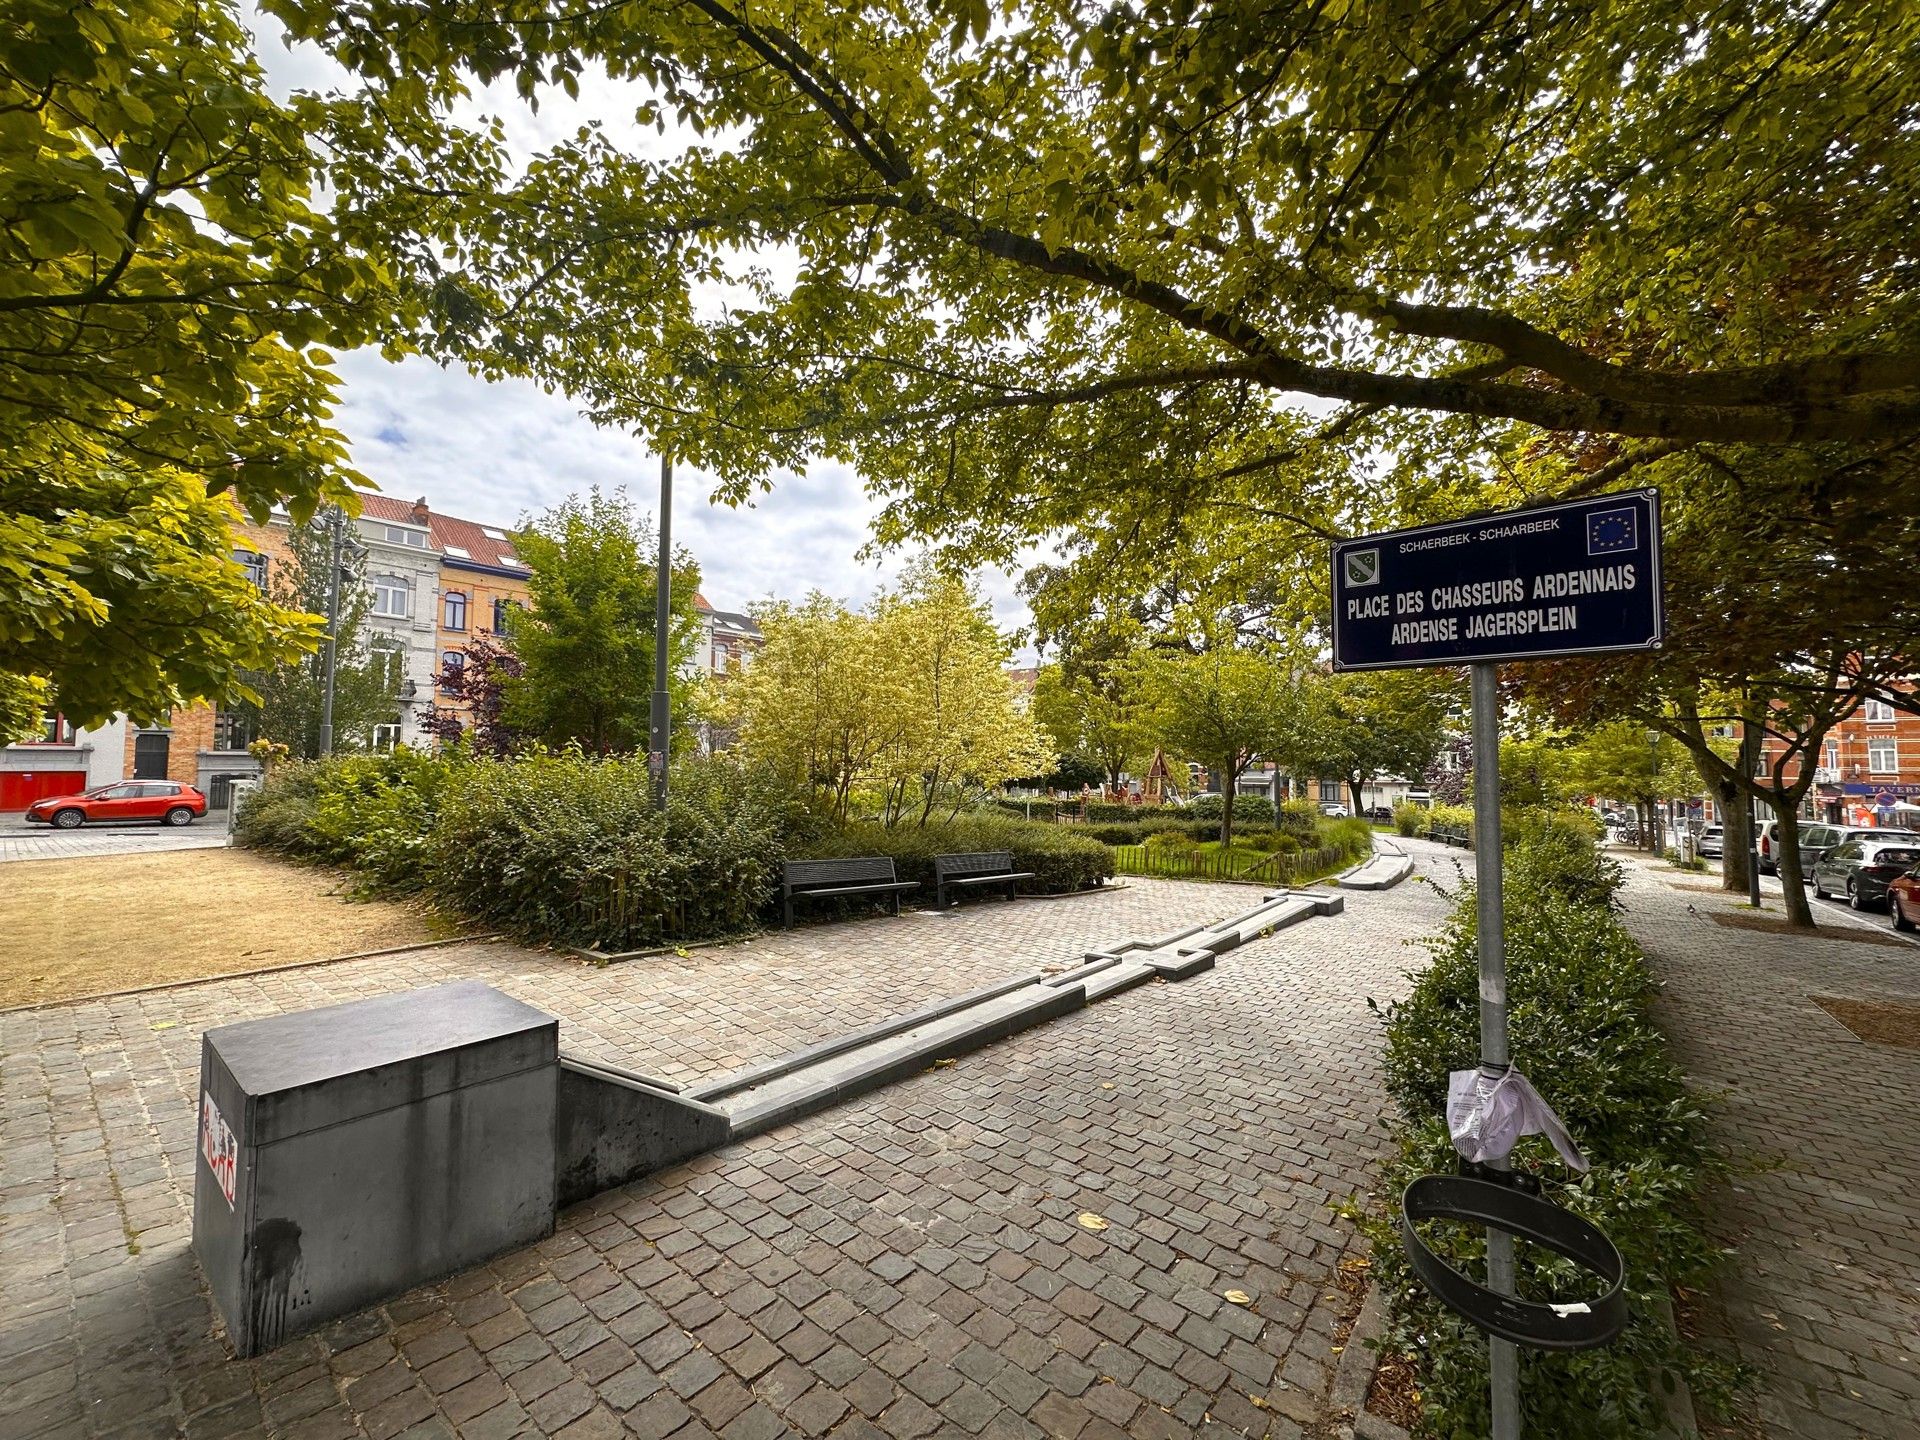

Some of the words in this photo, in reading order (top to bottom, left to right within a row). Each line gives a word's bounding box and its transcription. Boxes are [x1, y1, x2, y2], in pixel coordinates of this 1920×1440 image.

[1399, 533, 1470, 554] SCHAERBEEK
[1479, 518, 1560, 542] SCHAARBEEK
[1347, 595, 1390, 620] PLACE
[1396, 590, 1424, 614] DES
[1431, 577, 1524, 610] CHASSEURS
[1532, 563, 1636, 600] ARDENNAIS
[1391, 616, 1458, 646] ARDENSE
[1465, 605, 1577, 638] JAGERSPLEIN
